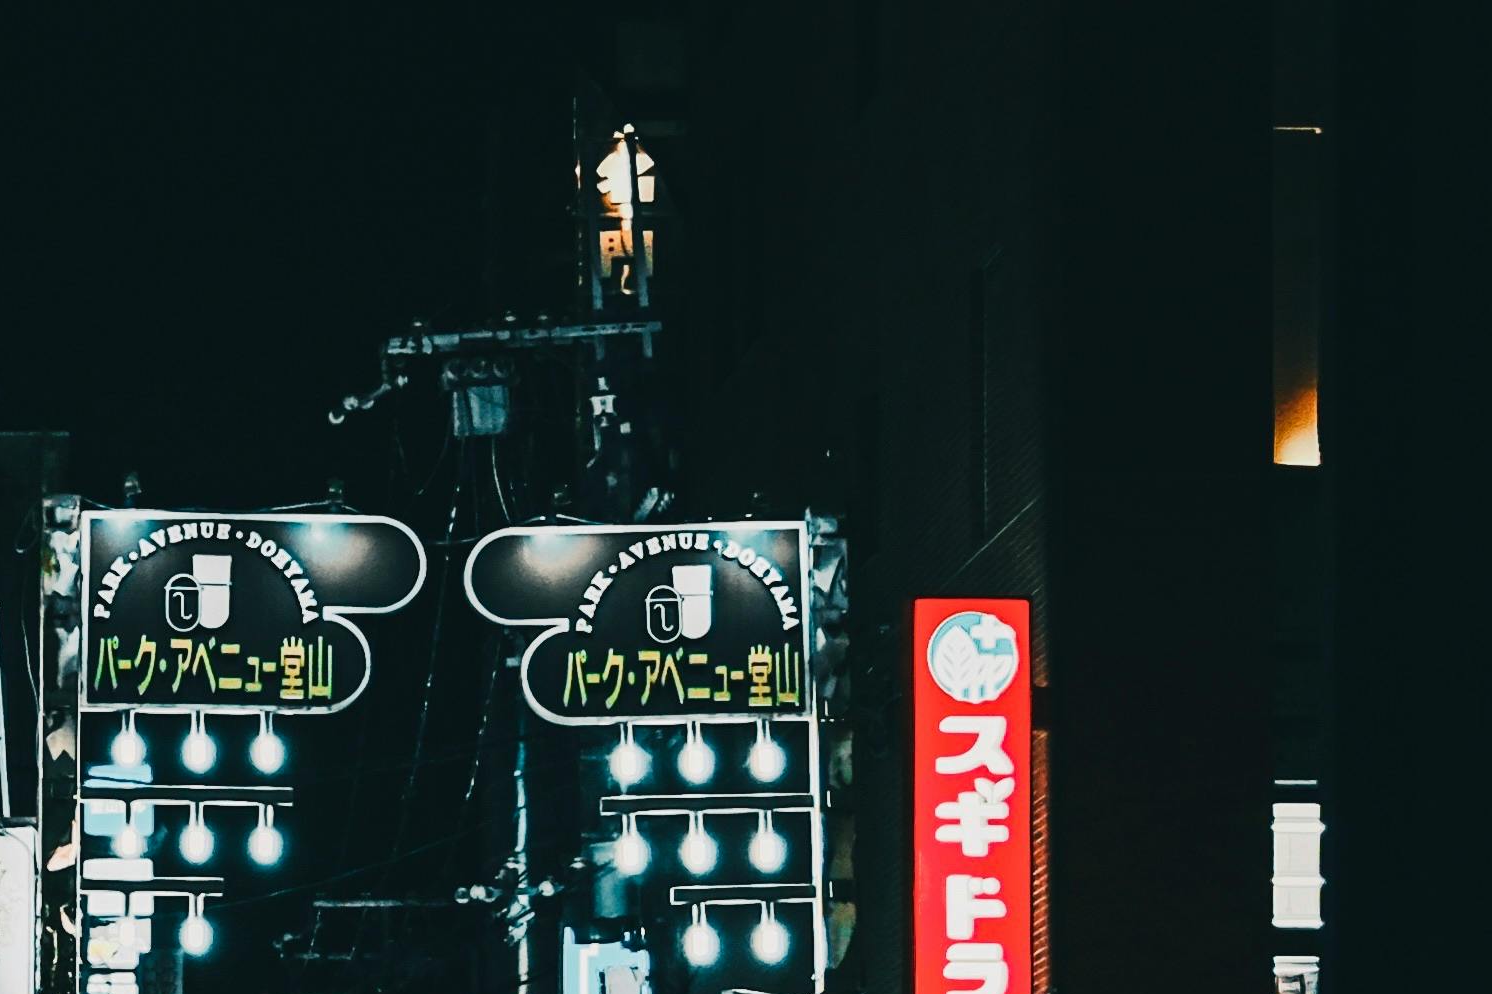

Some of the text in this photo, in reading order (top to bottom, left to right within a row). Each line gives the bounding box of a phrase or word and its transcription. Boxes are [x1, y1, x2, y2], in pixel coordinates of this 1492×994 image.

[93, 556, 133, 619] PARK
[139, 521, 232, 557] AVENUE
[575, 570, 614, 634] PARK
[618, 532, 710, 570] AVENUE
